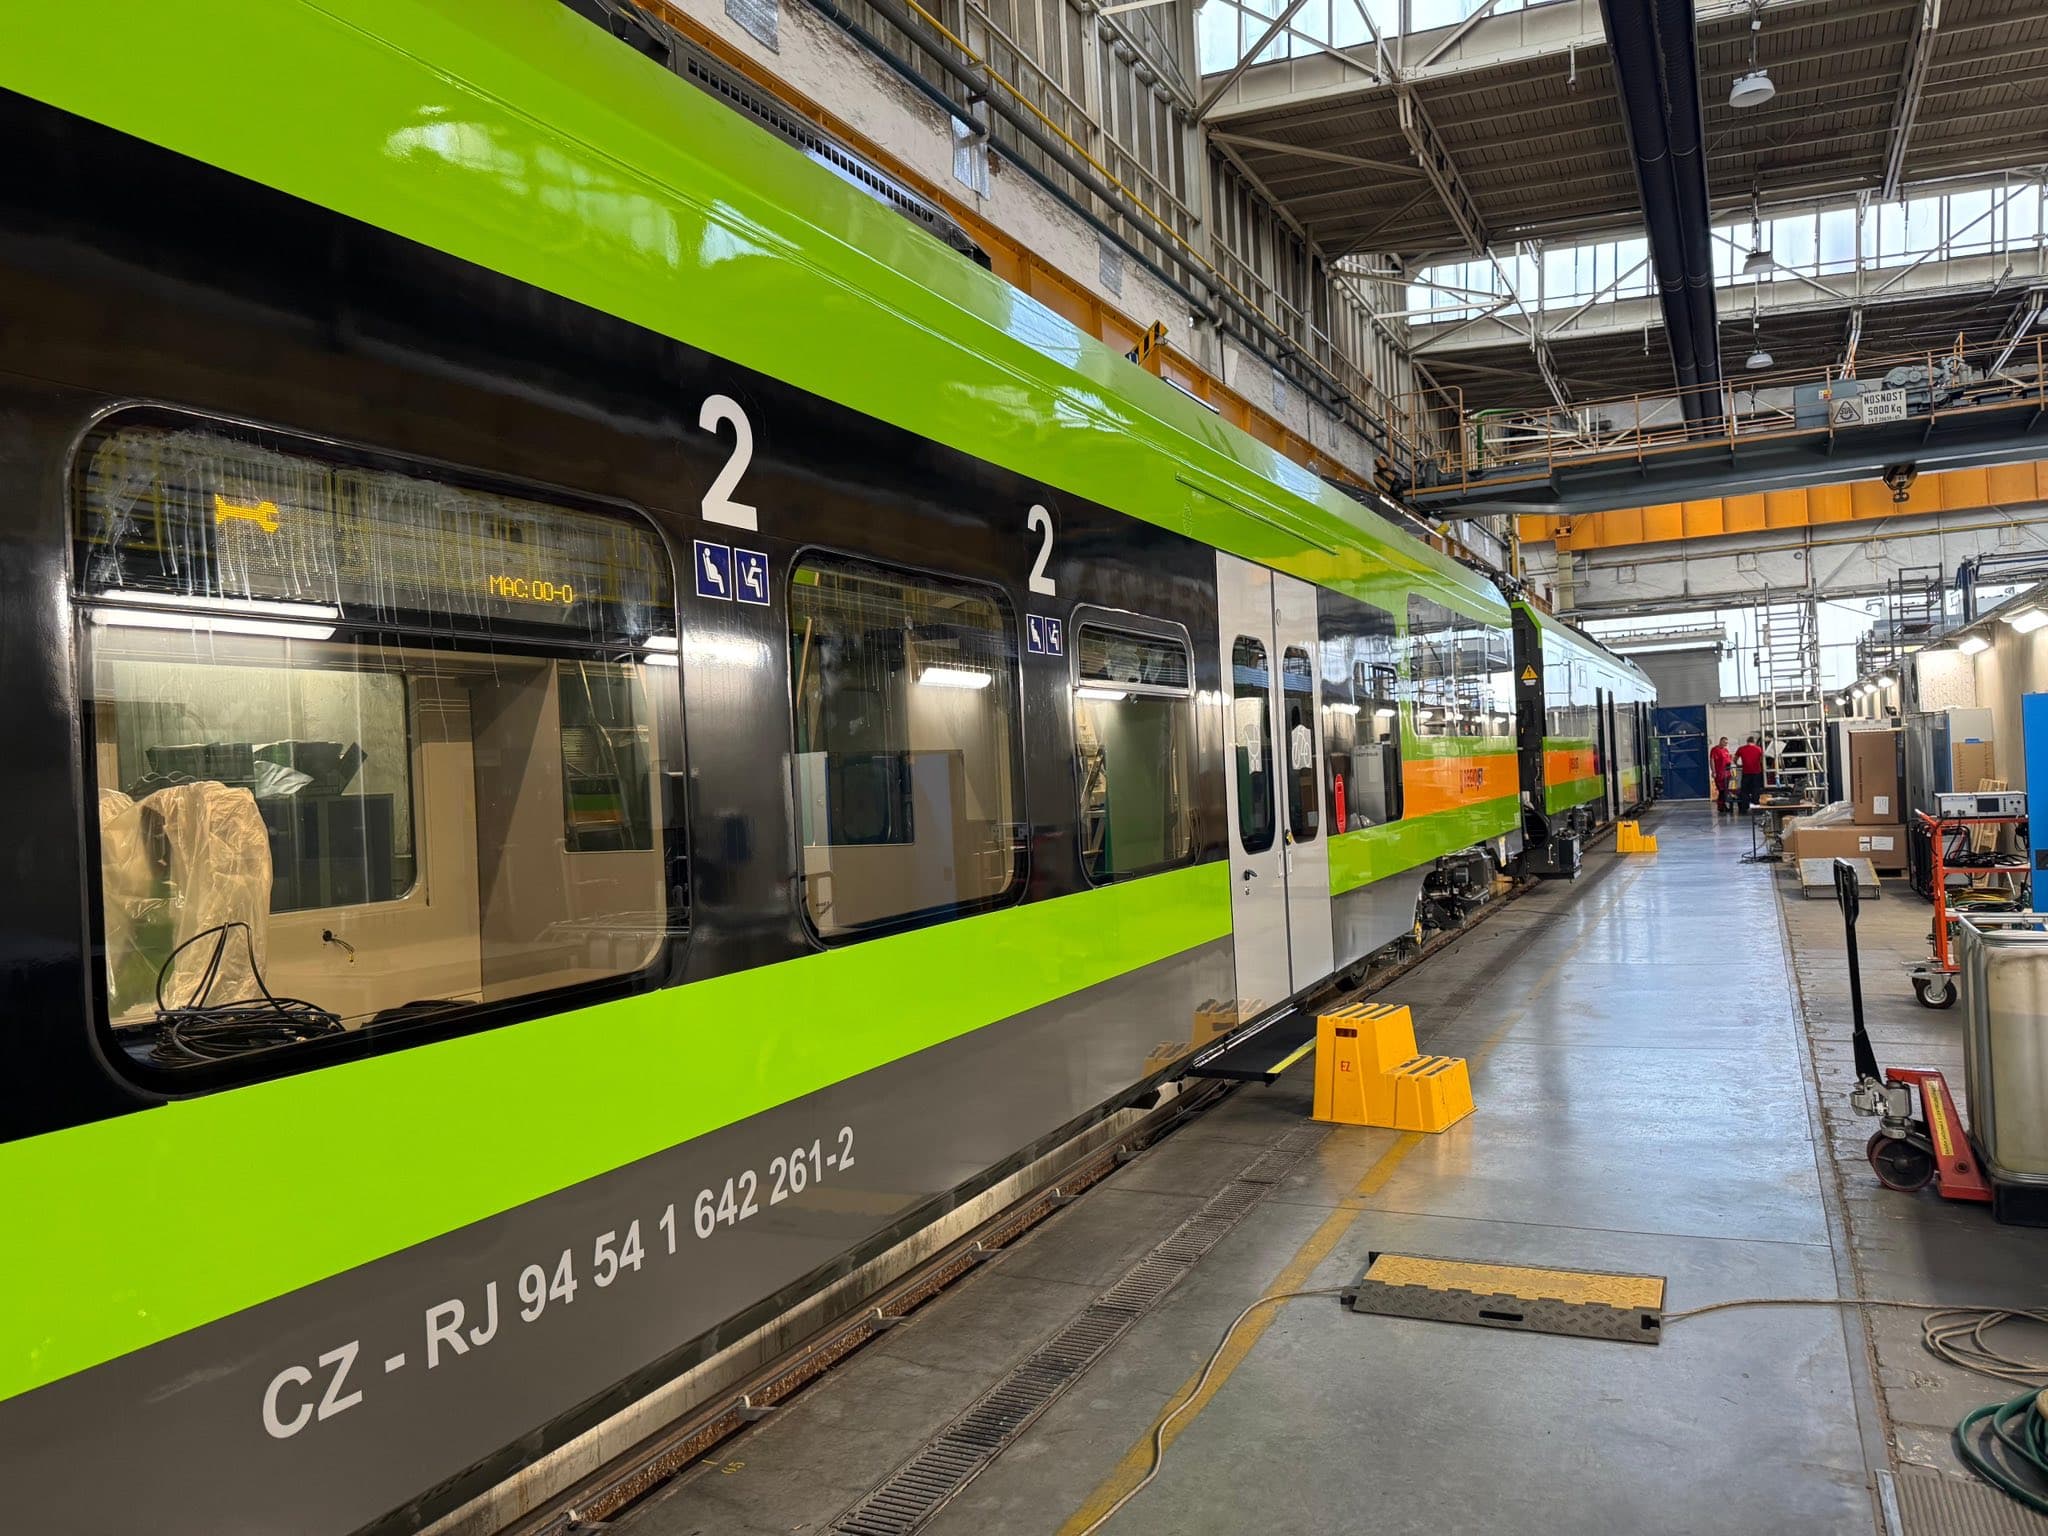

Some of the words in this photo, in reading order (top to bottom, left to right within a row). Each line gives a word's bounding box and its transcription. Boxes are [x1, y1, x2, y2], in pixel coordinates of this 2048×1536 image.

[1863, 391, 1903, 405] NOSNOST
[1868, 404, 1890, 416] 5000
[699, 394, 758, 531] 2
[1027, 504, 1056, 596] 2
[262, 1340, 363, 1440] CZ
[425, 1282, 499, 1369] RJ
[518, 1249, 578, 1322] 94
[593, 1219, 644, 1288] 54
[659, 1204, 677, 1254] 1
[694, 1170, 758, 1239] 642
[770, 1126, 854, 1205] 261-2
